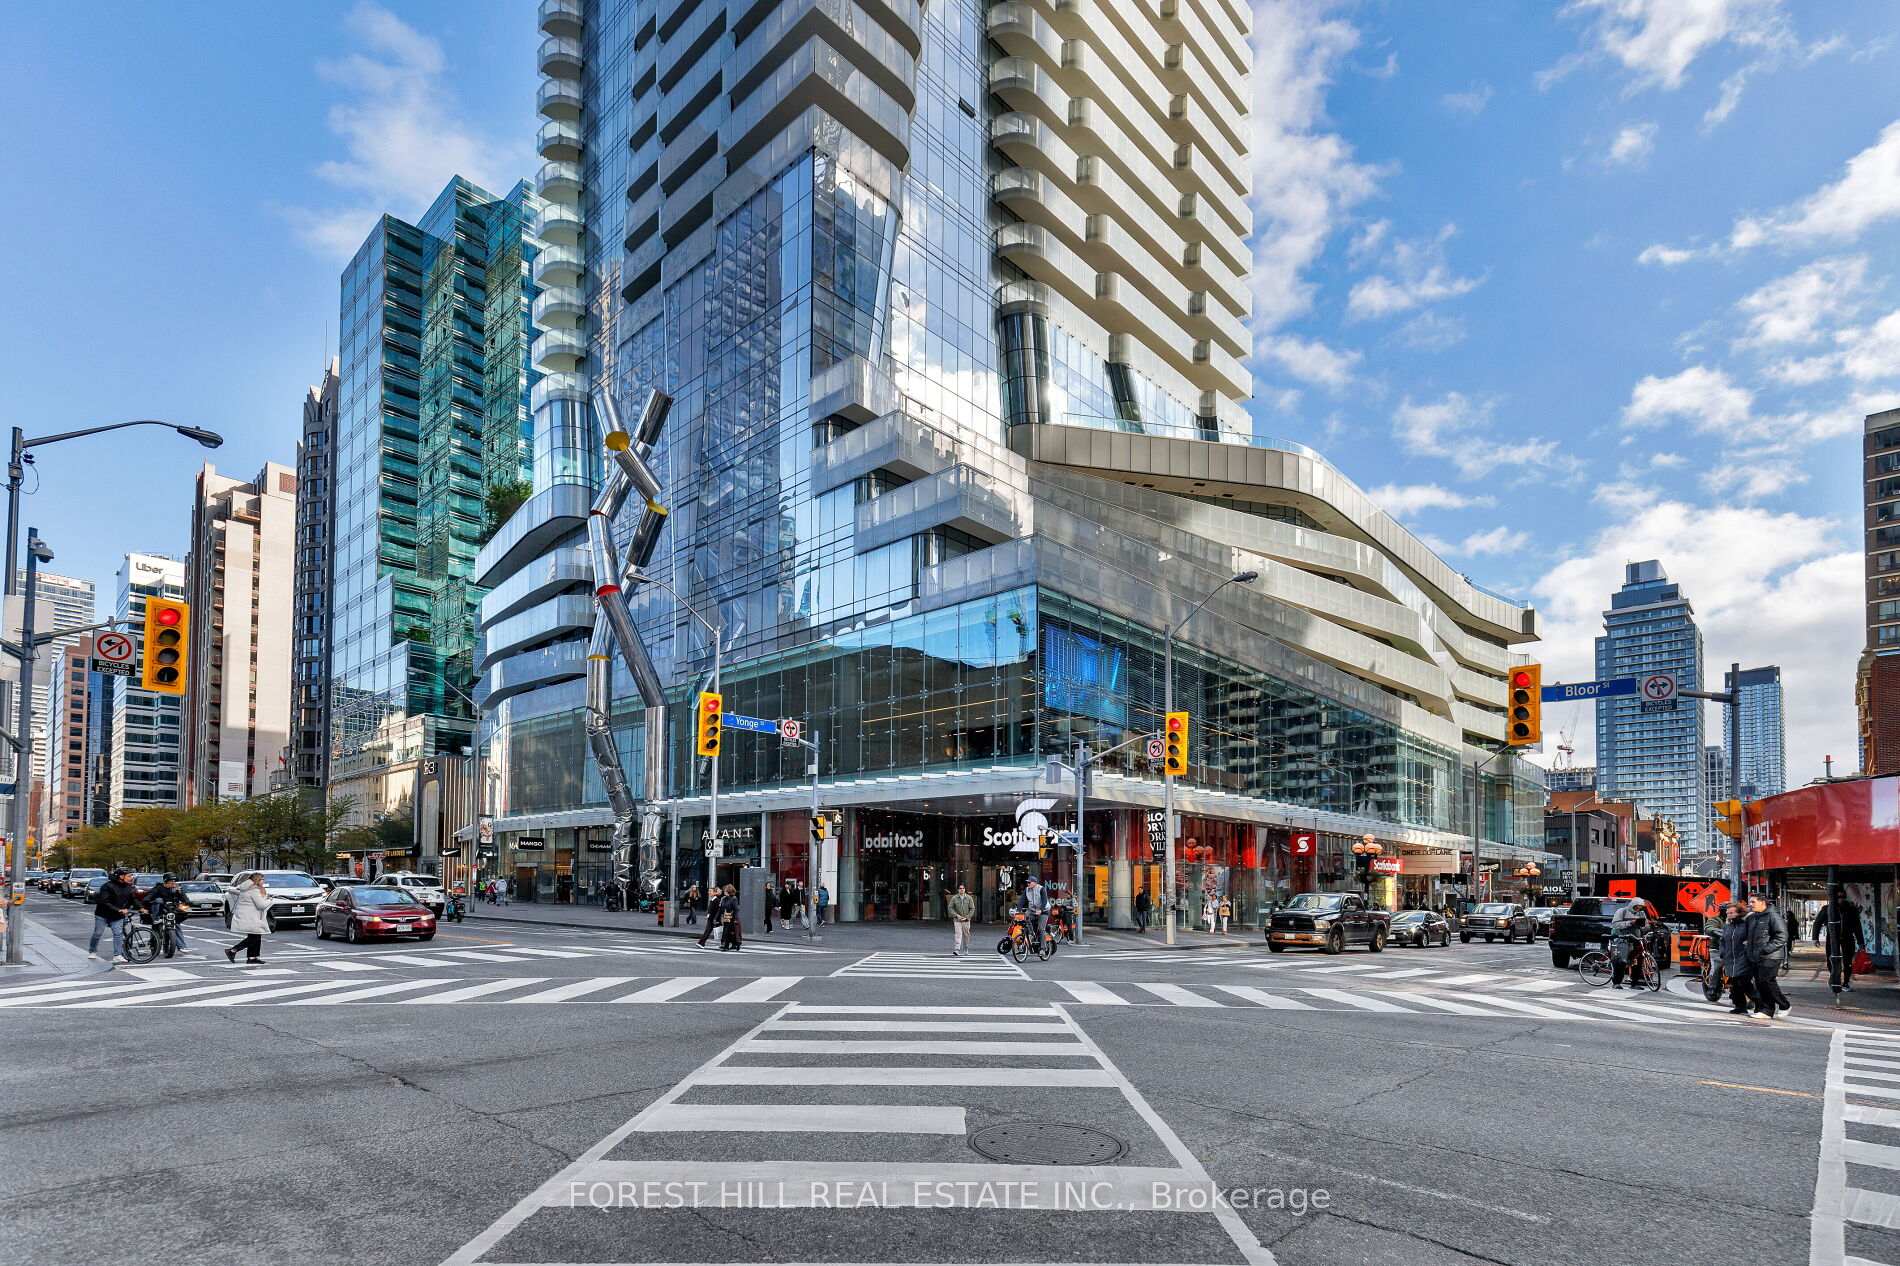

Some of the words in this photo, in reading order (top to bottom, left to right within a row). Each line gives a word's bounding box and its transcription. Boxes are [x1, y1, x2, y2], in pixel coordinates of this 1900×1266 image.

[135, 561, 164, 575] Uber
[98, 660, 130, 669] BICYCLES
[96, 667, 130, 676] EXCEPTED
[1565, 685, 1601, 697] Bloor
[735, 716, 759, 729] Yonge
[1373, 859, 1401, 872] Scotiabank
[1045, 880, 1068, 891] Now
